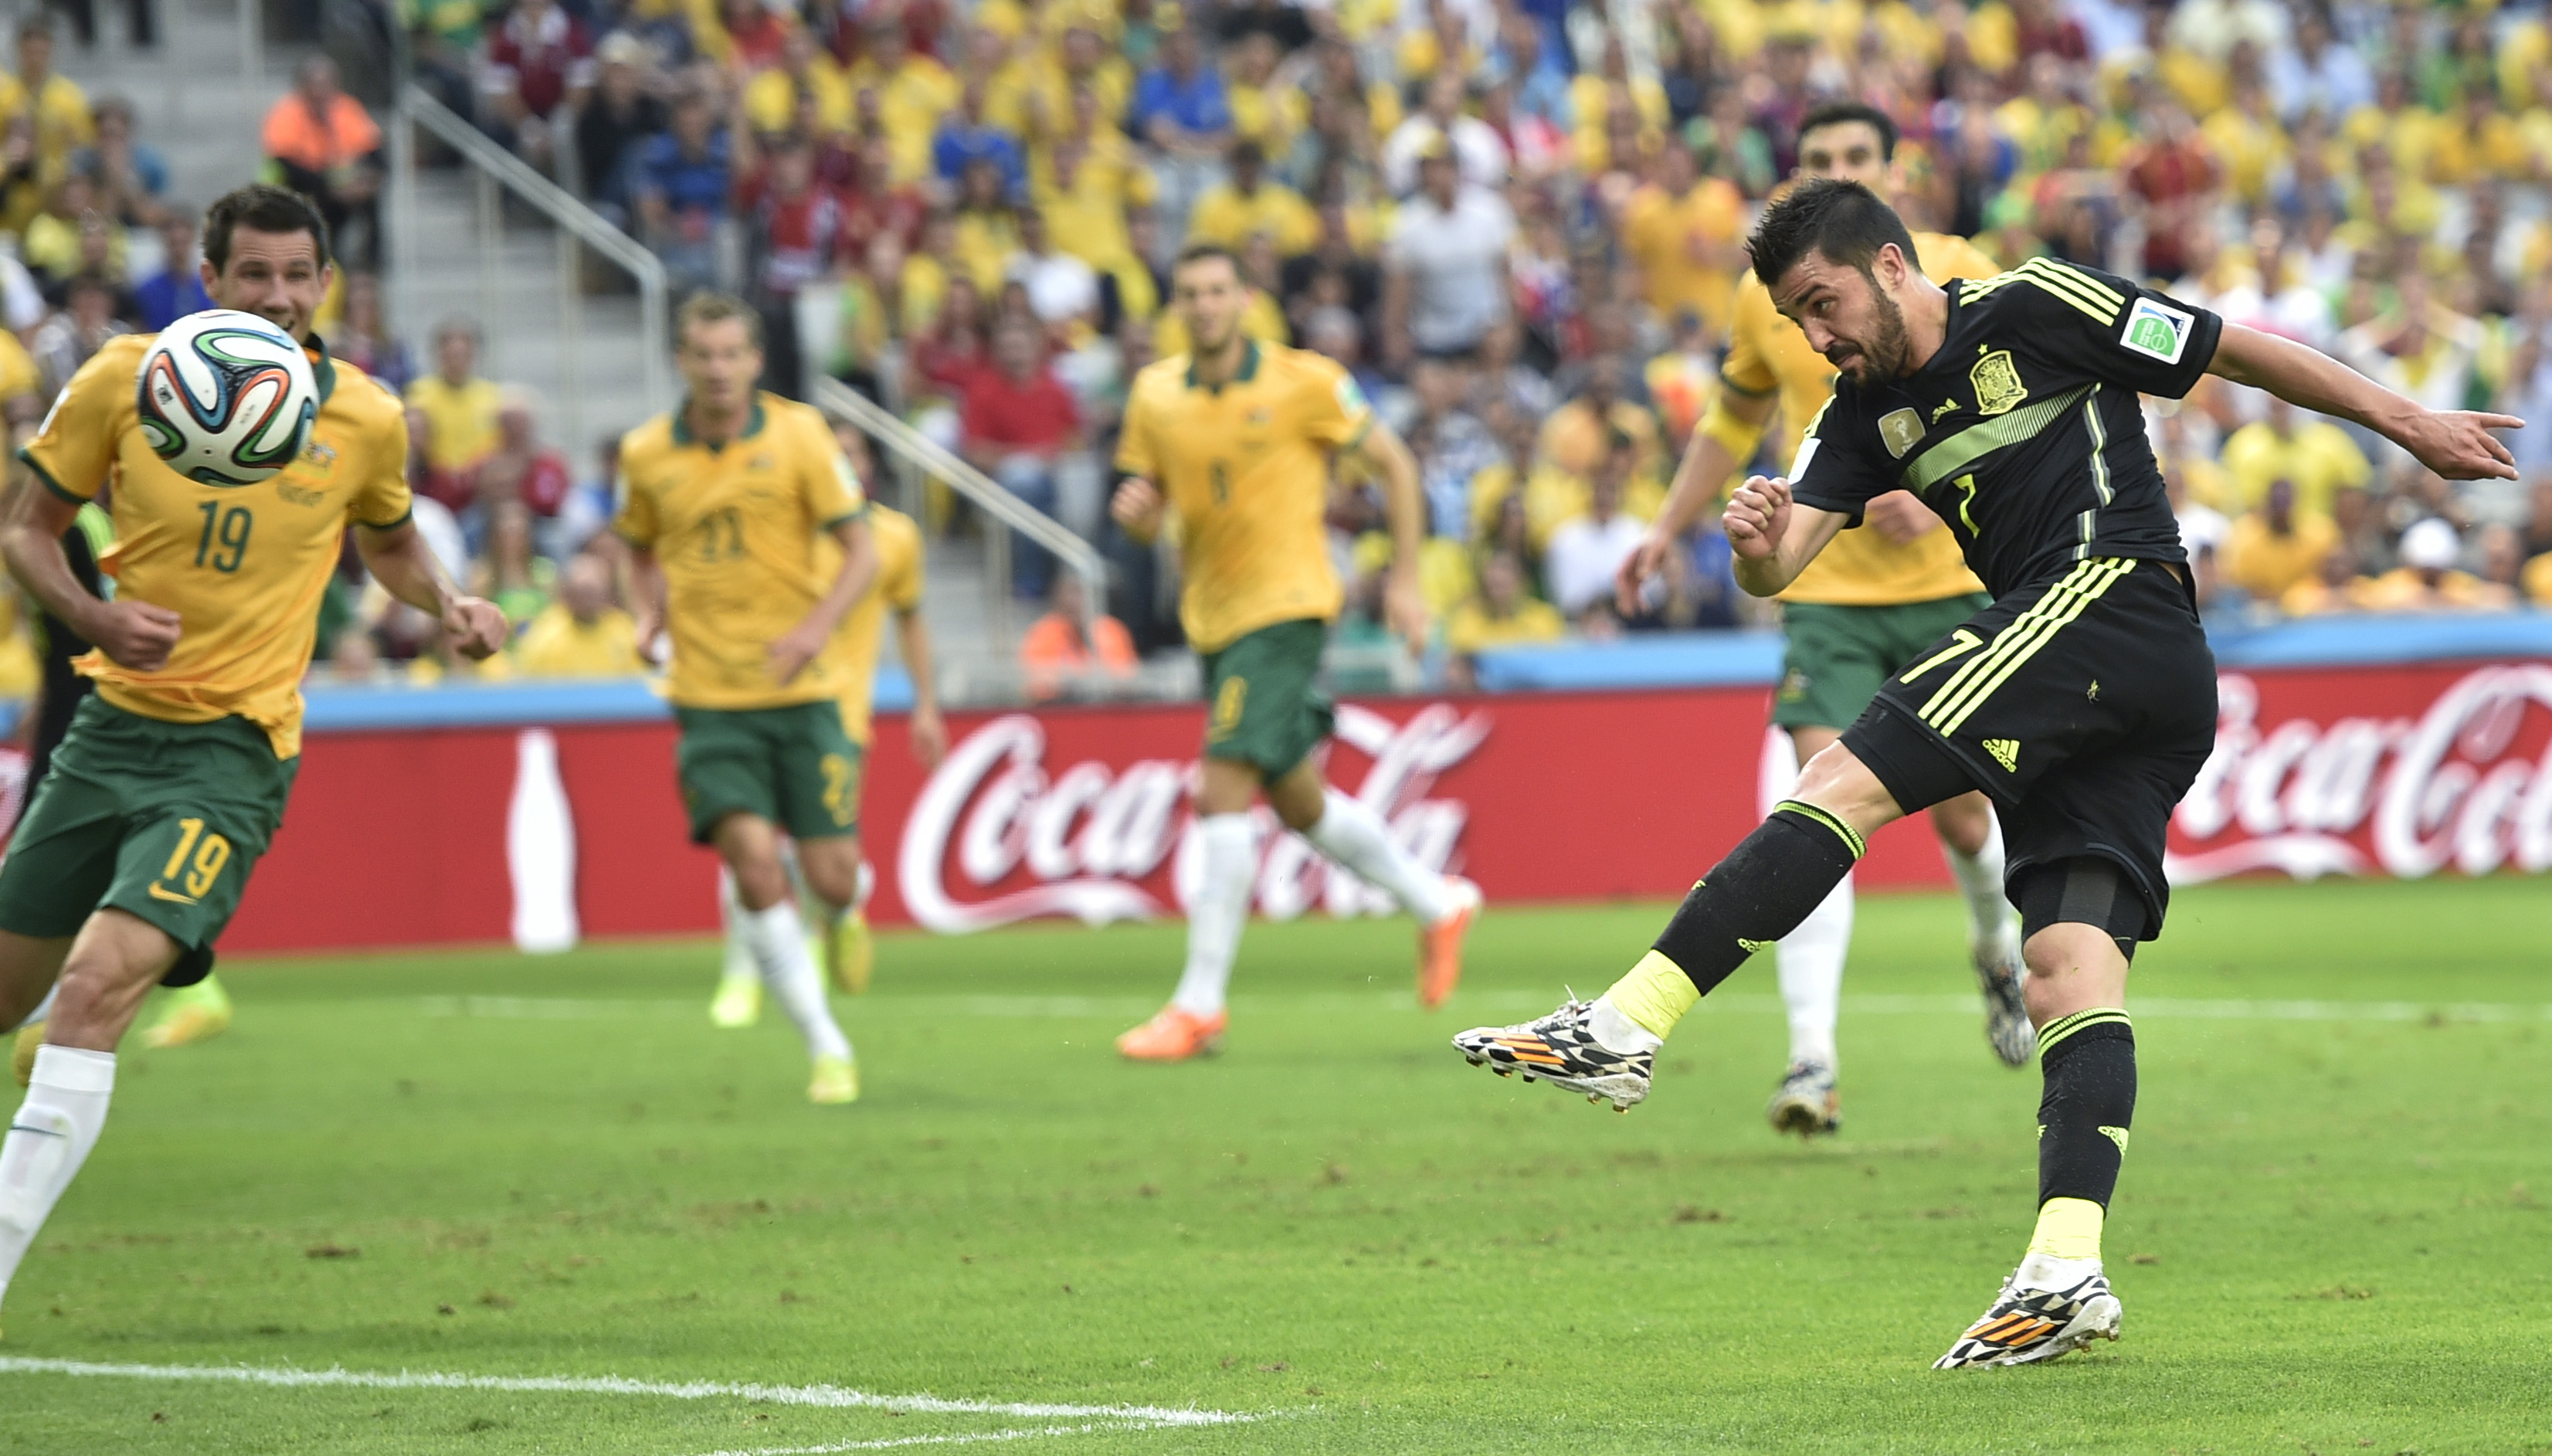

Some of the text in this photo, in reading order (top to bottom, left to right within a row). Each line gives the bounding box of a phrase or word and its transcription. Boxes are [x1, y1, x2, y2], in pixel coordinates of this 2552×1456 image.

[195, 500, 253, 574] 19
[1952, 473, 1980, 539] 7
[1899, 629, 1984, 684] 7
[1982, 739, 2018, 772] adidas
[163, 817, 231, 899] 19
